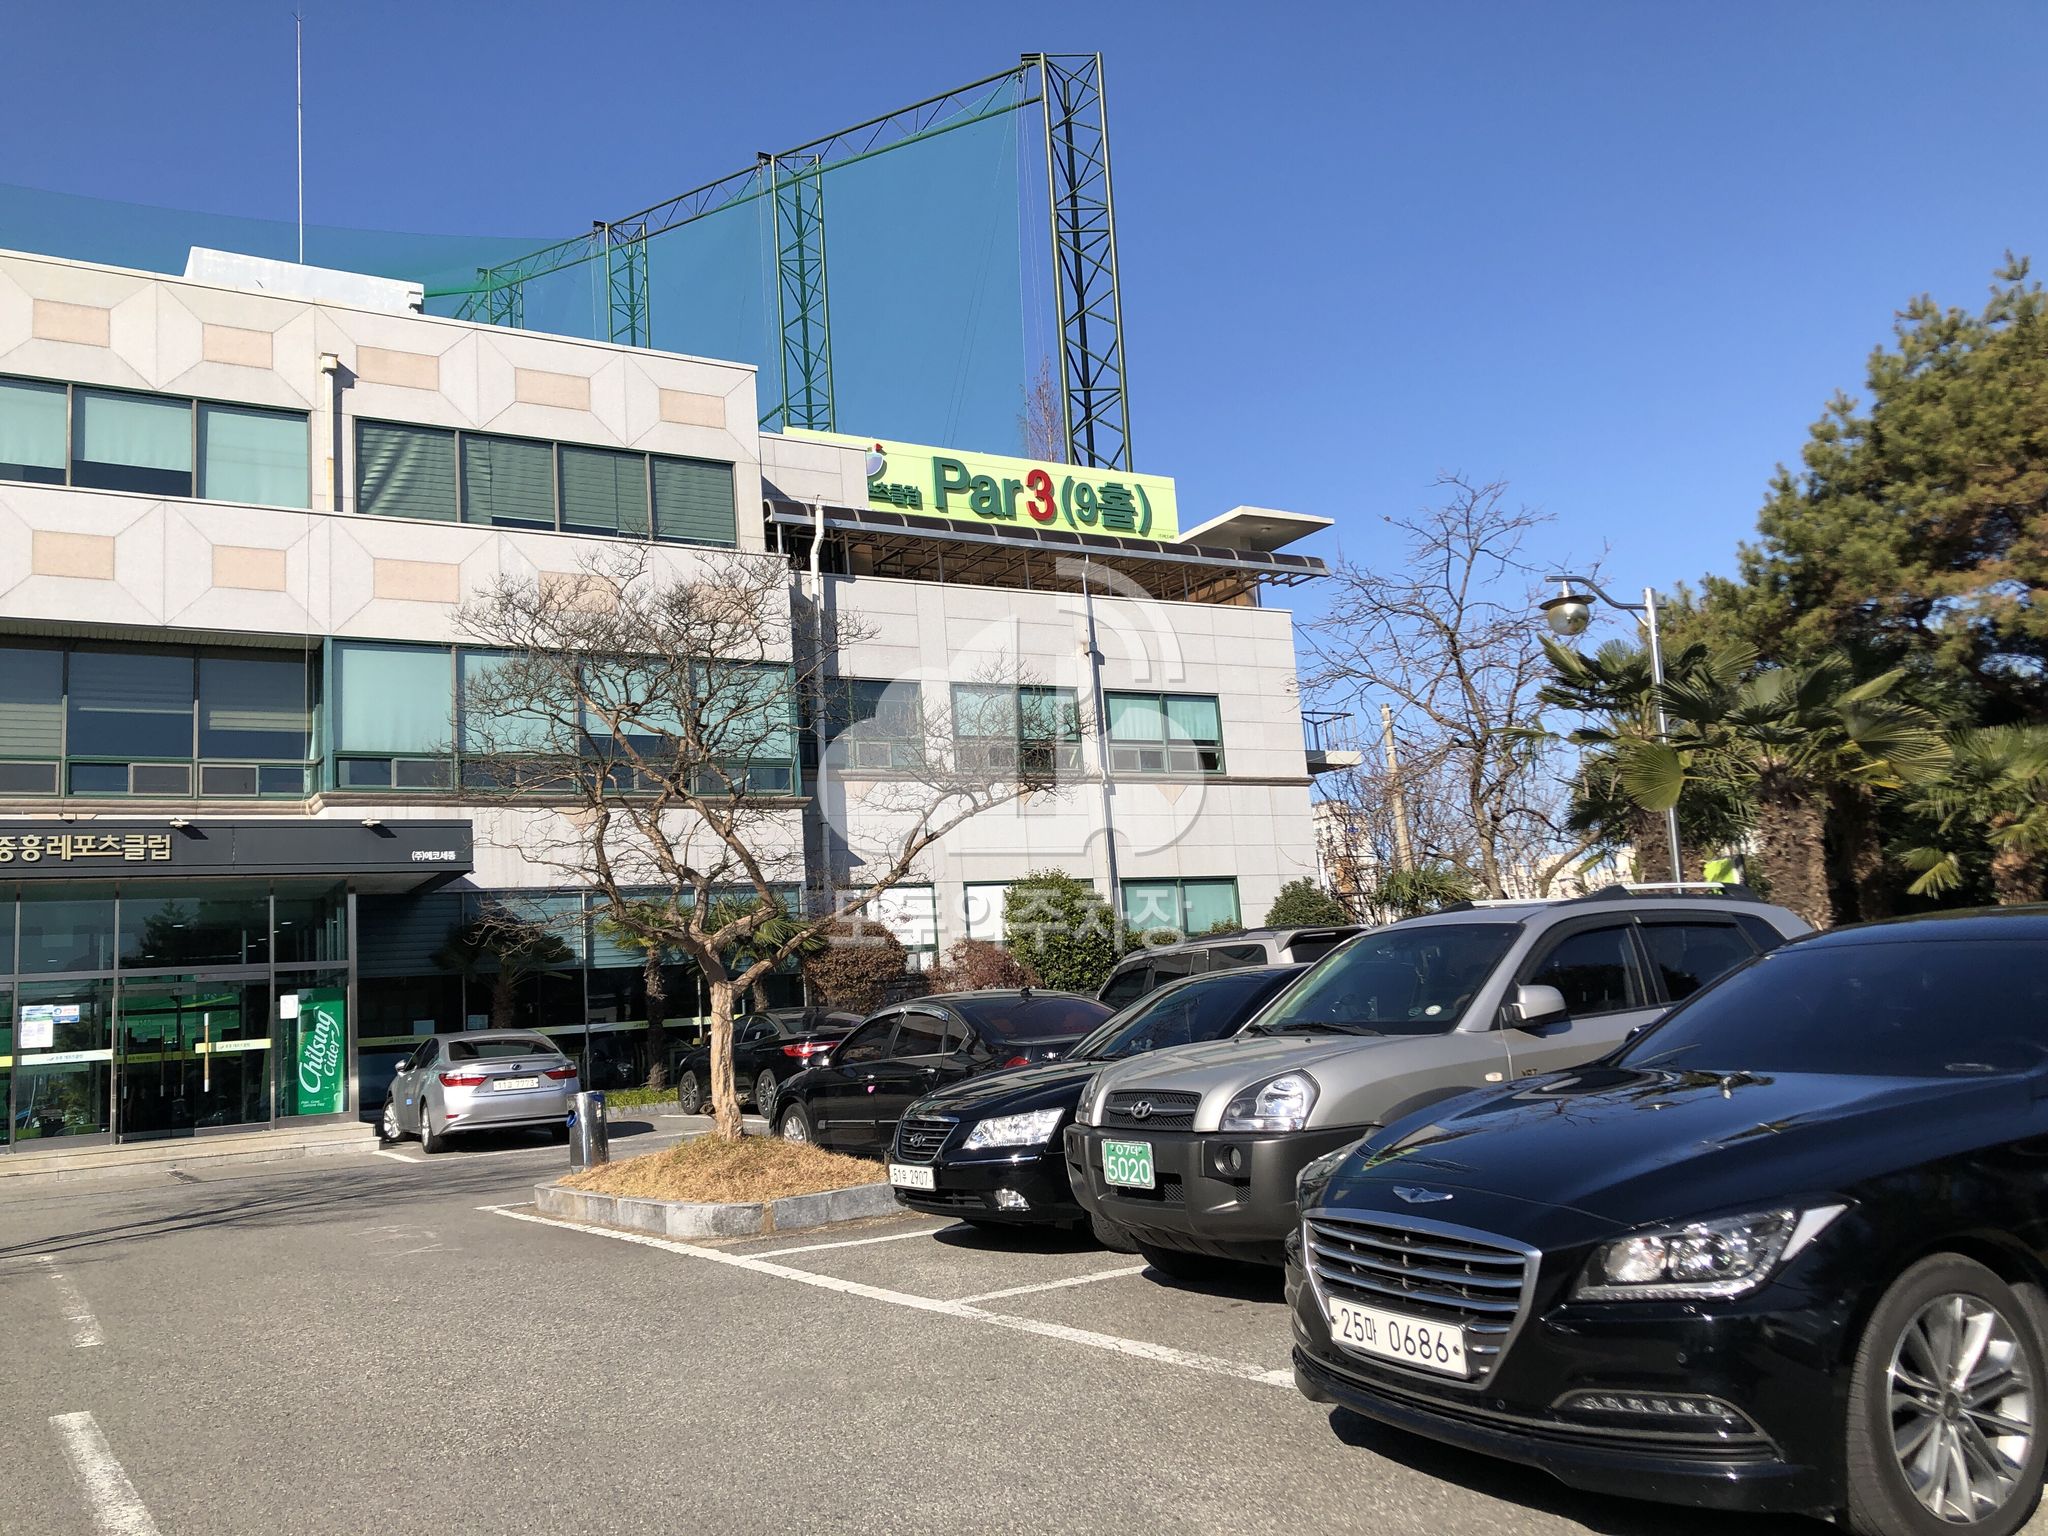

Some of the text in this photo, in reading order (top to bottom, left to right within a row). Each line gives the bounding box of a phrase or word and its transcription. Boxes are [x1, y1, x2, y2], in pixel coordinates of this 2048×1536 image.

[0, 834, 171, 862] 중흥레포츠클럽
[299, 1010, 340, 1094] Chilsung
[324, 1030, 340, 1077] Cider
[909, 1169, 928, 1186] 2907
[1108, 1155, 1150, 1184] 5020
[1340, 1307, 1450, 1364] 25마 0686
